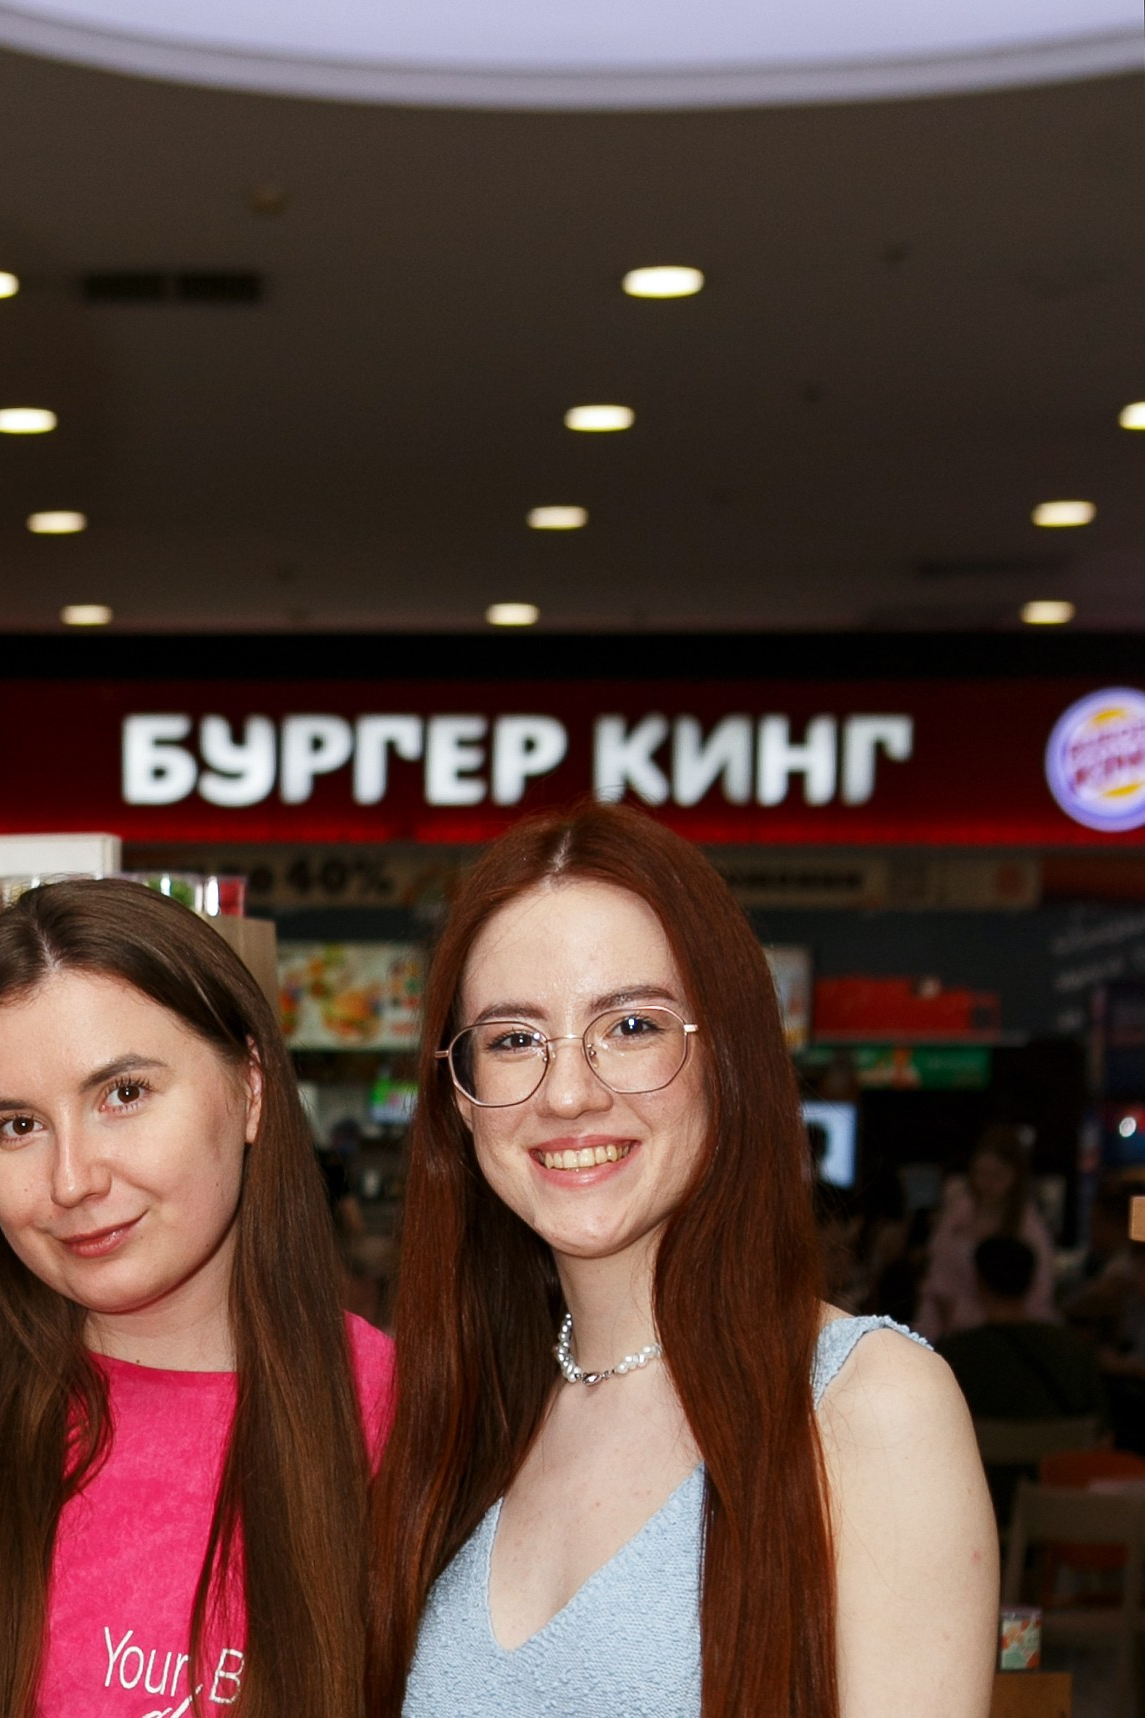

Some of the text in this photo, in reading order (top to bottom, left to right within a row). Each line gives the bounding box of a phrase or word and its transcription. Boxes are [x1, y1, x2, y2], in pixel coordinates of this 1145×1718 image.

[122, 713, 913, 807] БУРГЕР КИНГ
[104, 1626, 189, 1697] Your
